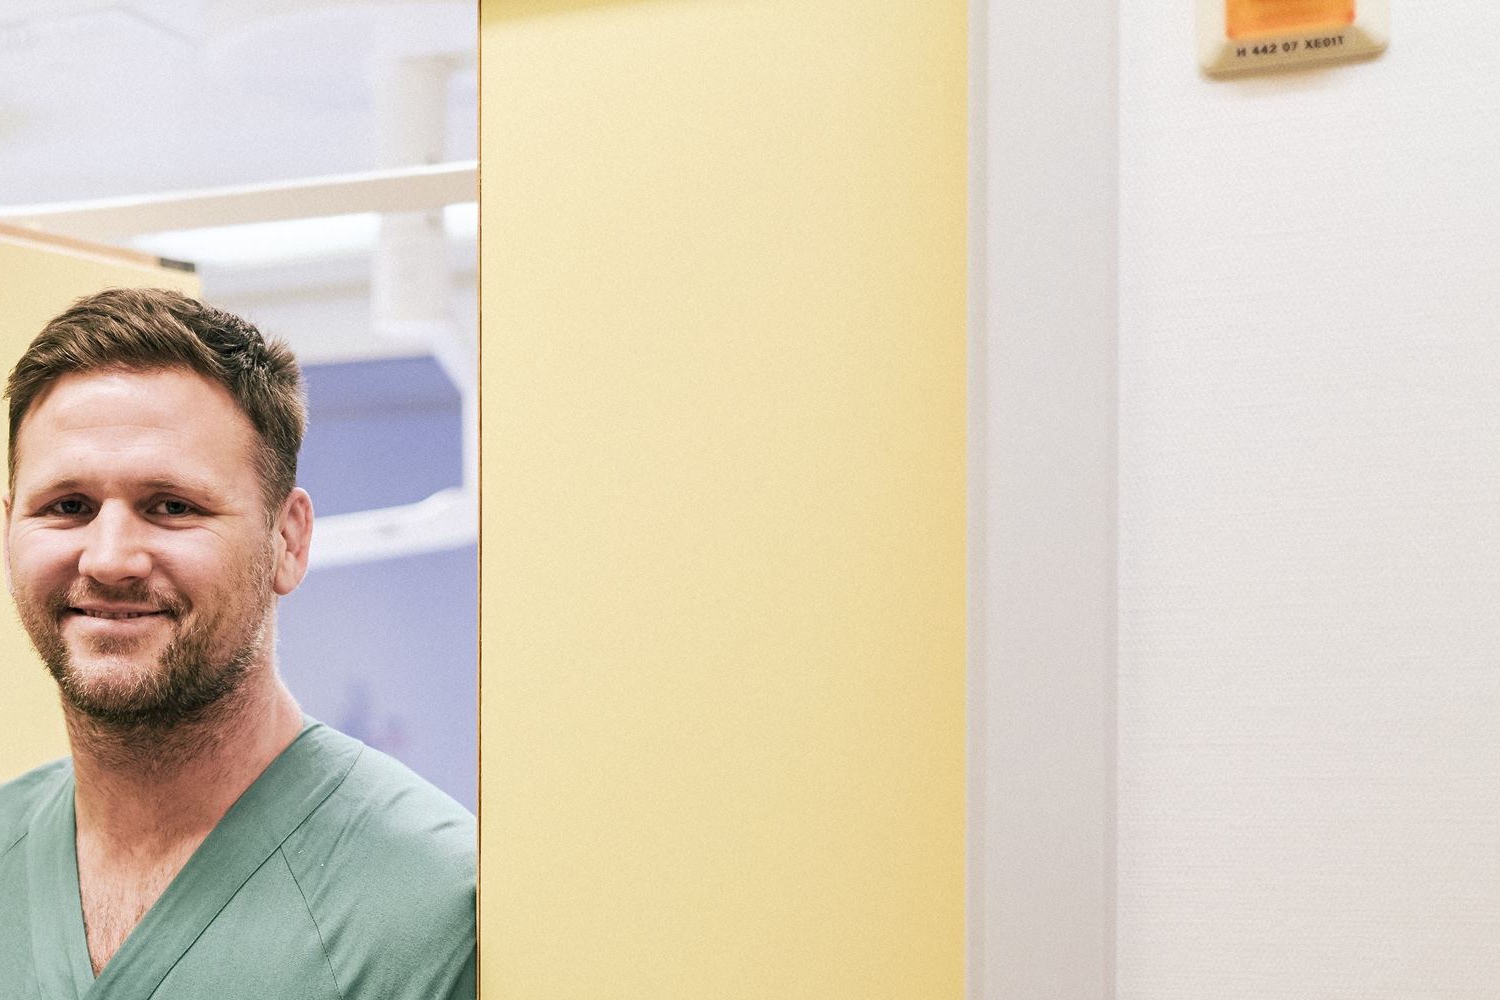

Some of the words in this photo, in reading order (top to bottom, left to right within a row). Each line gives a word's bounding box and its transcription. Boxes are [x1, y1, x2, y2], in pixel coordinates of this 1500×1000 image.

[1236, 47, 1247, 57] H
[1252, 43, 1278, 55] 442
[1282, 41, 1299, 52] 07
